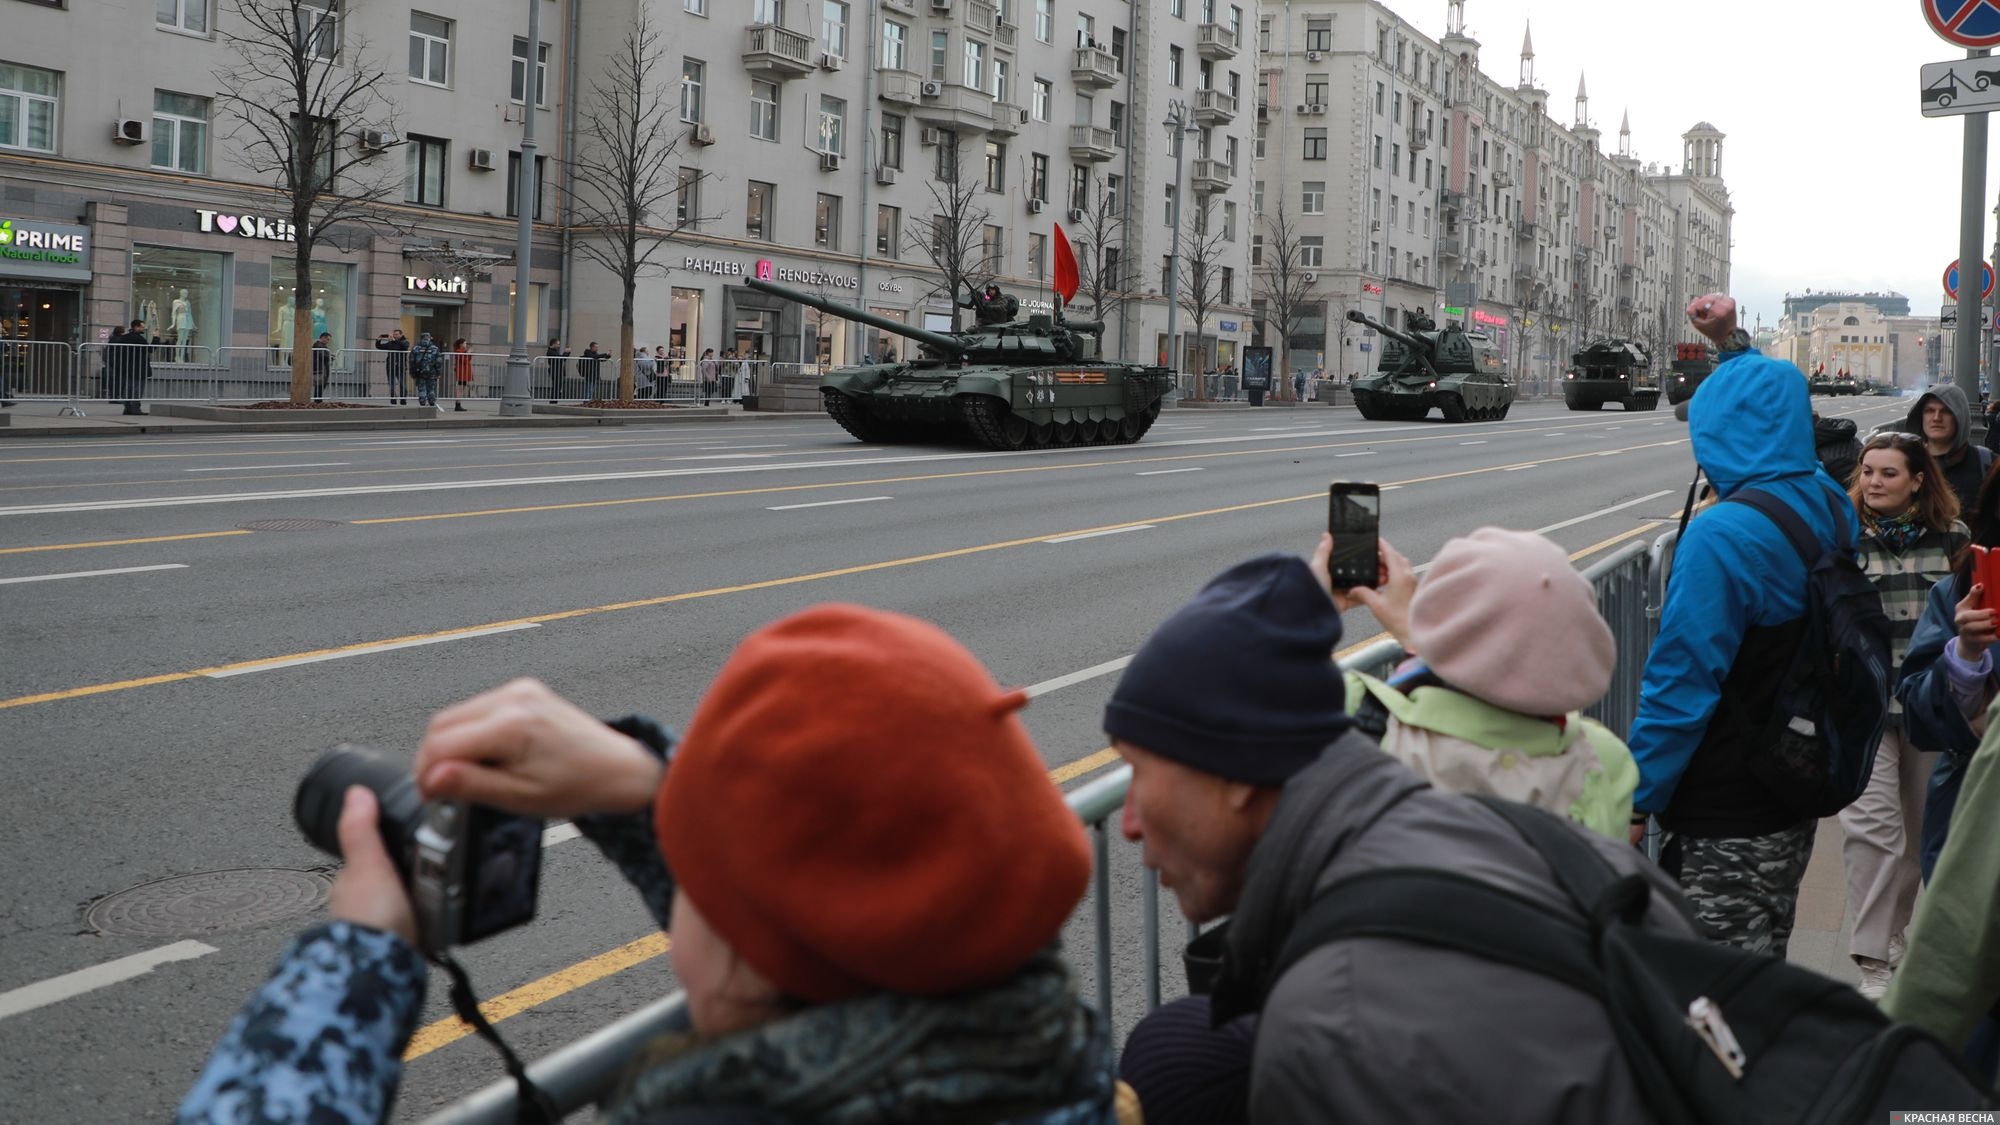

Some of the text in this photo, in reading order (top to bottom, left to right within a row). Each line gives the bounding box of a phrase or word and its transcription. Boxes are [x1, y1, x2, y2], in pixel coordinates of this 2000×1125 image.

[15, 229, 83, 252] PRIME
[0, 246, 42, 261] Natural
[685, 257, 747, 275] РАНДЕВУ
[779, 267, 858, 289] RENDEZ-VOUS
[879, 282, 903, 292] ОБУВЬ
[1019, 299, 1027, 307] LE
[1028, 300, 1055, 310] JOURNA
